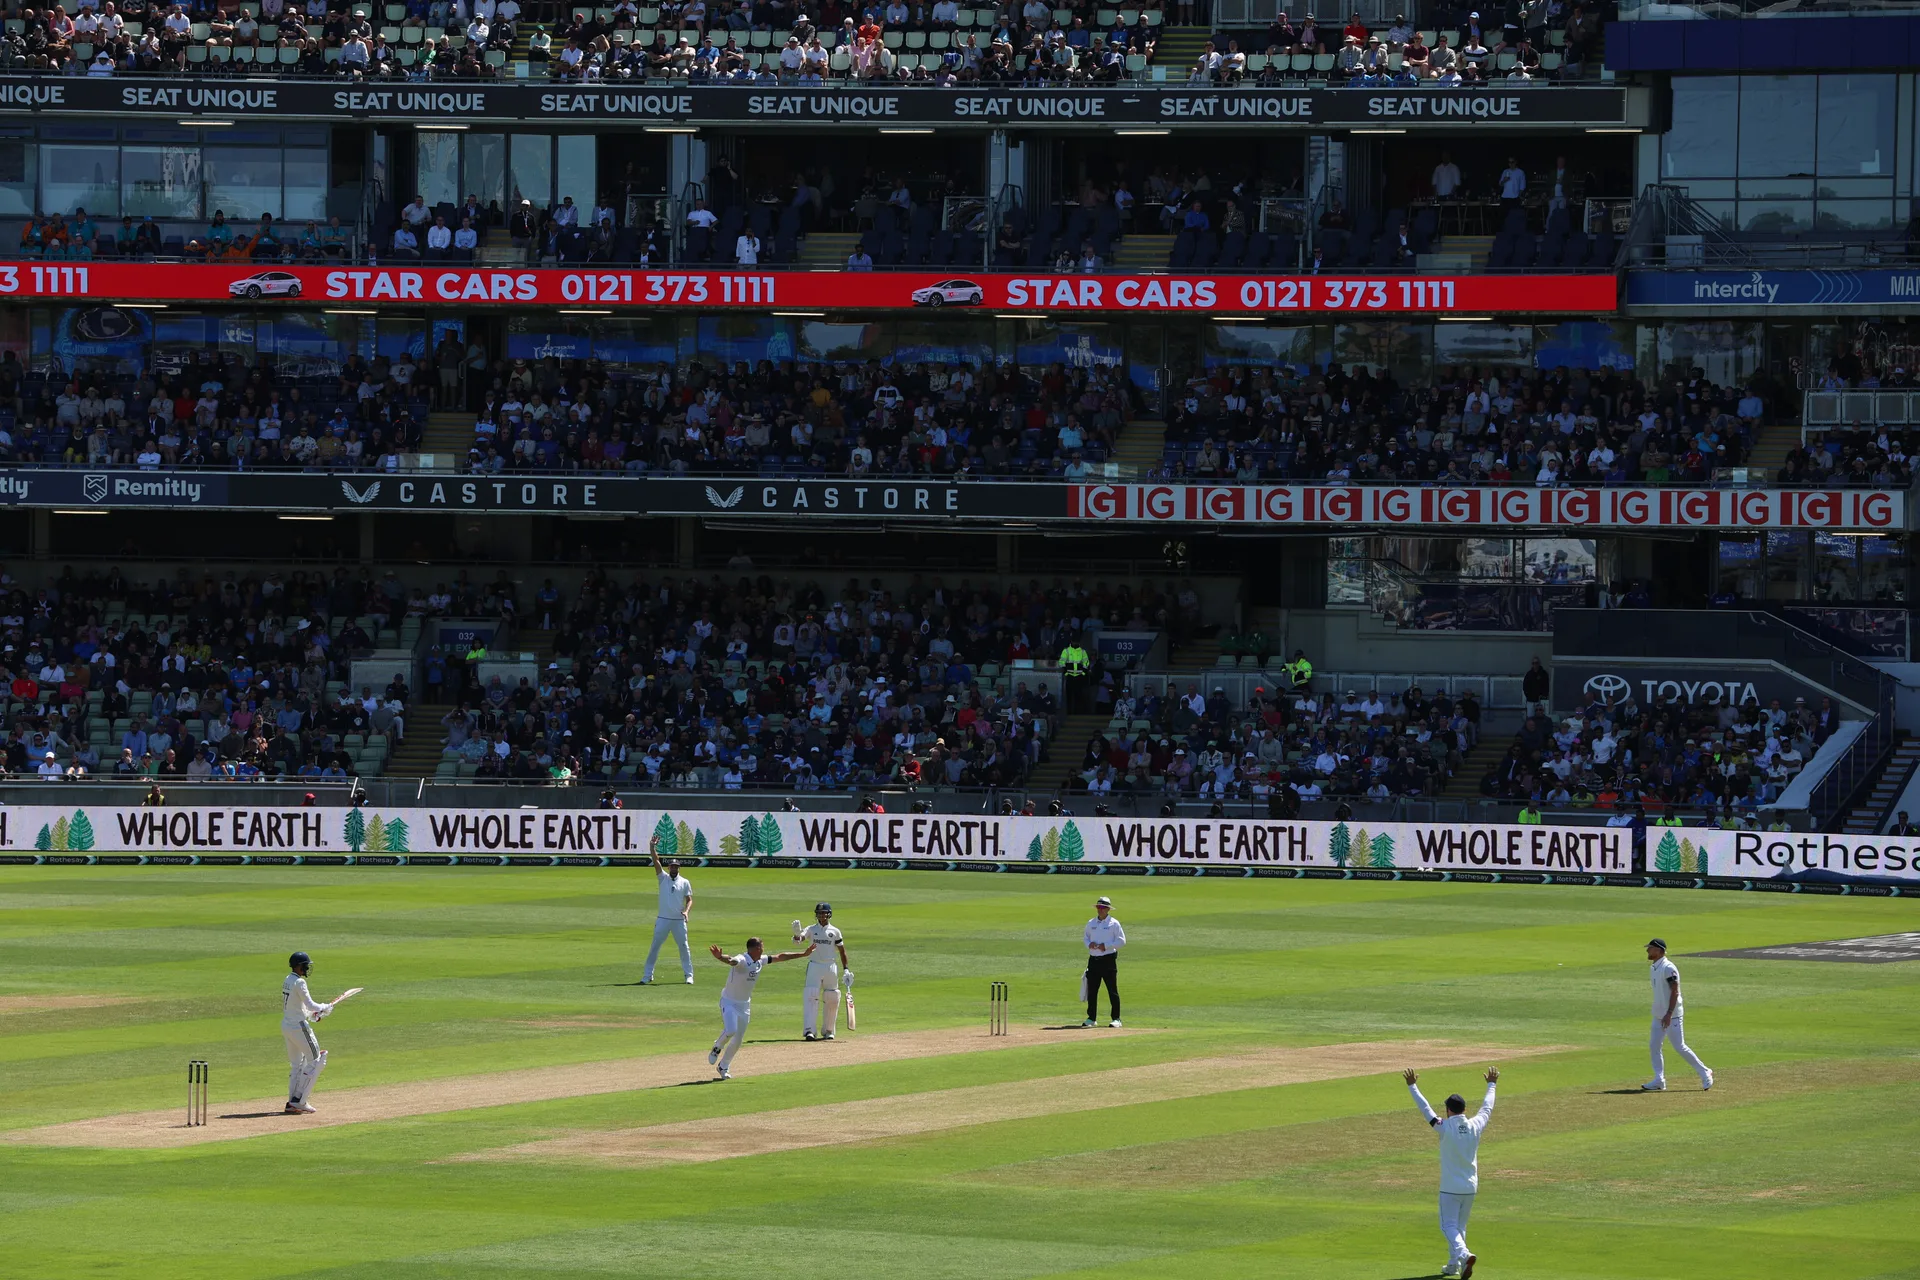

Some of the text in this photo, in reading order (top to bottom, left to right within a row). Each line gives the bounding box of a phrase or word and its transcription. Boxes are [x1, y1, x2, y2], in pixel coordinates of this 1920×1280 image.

[123, 88, 276, 108] SEAT UNIQUE
[334, 92, 485, 112] SEAT UNIQUE
[541, 94, 693, 115] SEAT UNIQUE
[748, 96, 899, 117] SEAT UNIQUE
[954, 97, 1105, 118] SEAT UNIQUE
[1160, 97, 1312, 117] SEAT UNIQUE
[1367, 97, 1521, 117] SEAT UNIQUE
[31, 267, 87, 293] 1111
[326, 272, 774, 302] STAR CARS 0121 373 1111
[1007, 279, 1454, 307] STAR CARS 0121 373 1111
[1694, 280, 1779, 303] intercity
[115, 478, 200, 501] Remitly
[400, 482, 598, 505] CASTORE
[762, 486, 959, 510] CASTORE
[1079, 486, 1115, 519] IG
[1138, 487, 1175, 519] IG
[1197, 488, 1234, 520] IG
[1256, 488, 1292, 520] IG
[1314, 489, 1352, 522] IG
[1373, 489, 1411, 522] IG
[1433, 489, 1470, 522] IG
[1491, 490, 1529, 523] IG
[1552, 490, 1589, 523] IG
[1611, 491, 1648, 524] IG
[1671, 491, 1709, 525] IG
[1731, 492, 1769, 525] IG
[1792, 492, 1830, 526] IG
[1853, 493, 1892, 526] IG
[458, 632, 475, 641] 032
[1117, 642, 1133, 651] 033
[1641, 681, 1759, 705] TOYOTA
[117, 812, 224, 846] WHOLE
[233, 812, 321, 847] EARTH
[430, 815, 535, 849] WHOLE
[544, 815, 631, 850] EARTH
[800, 819, 903, 853] WHOLE
[912, 819, 999, 856] EARTH
[1106, 824, 1210, 858] WHOLE
[1220, 823, 1308, 862] EARTH
[662, 858, 697, 866] Roesay
[1415, 829, 1522, 865] WHOLE
[1532, 831, 1619, 869] EARTH
